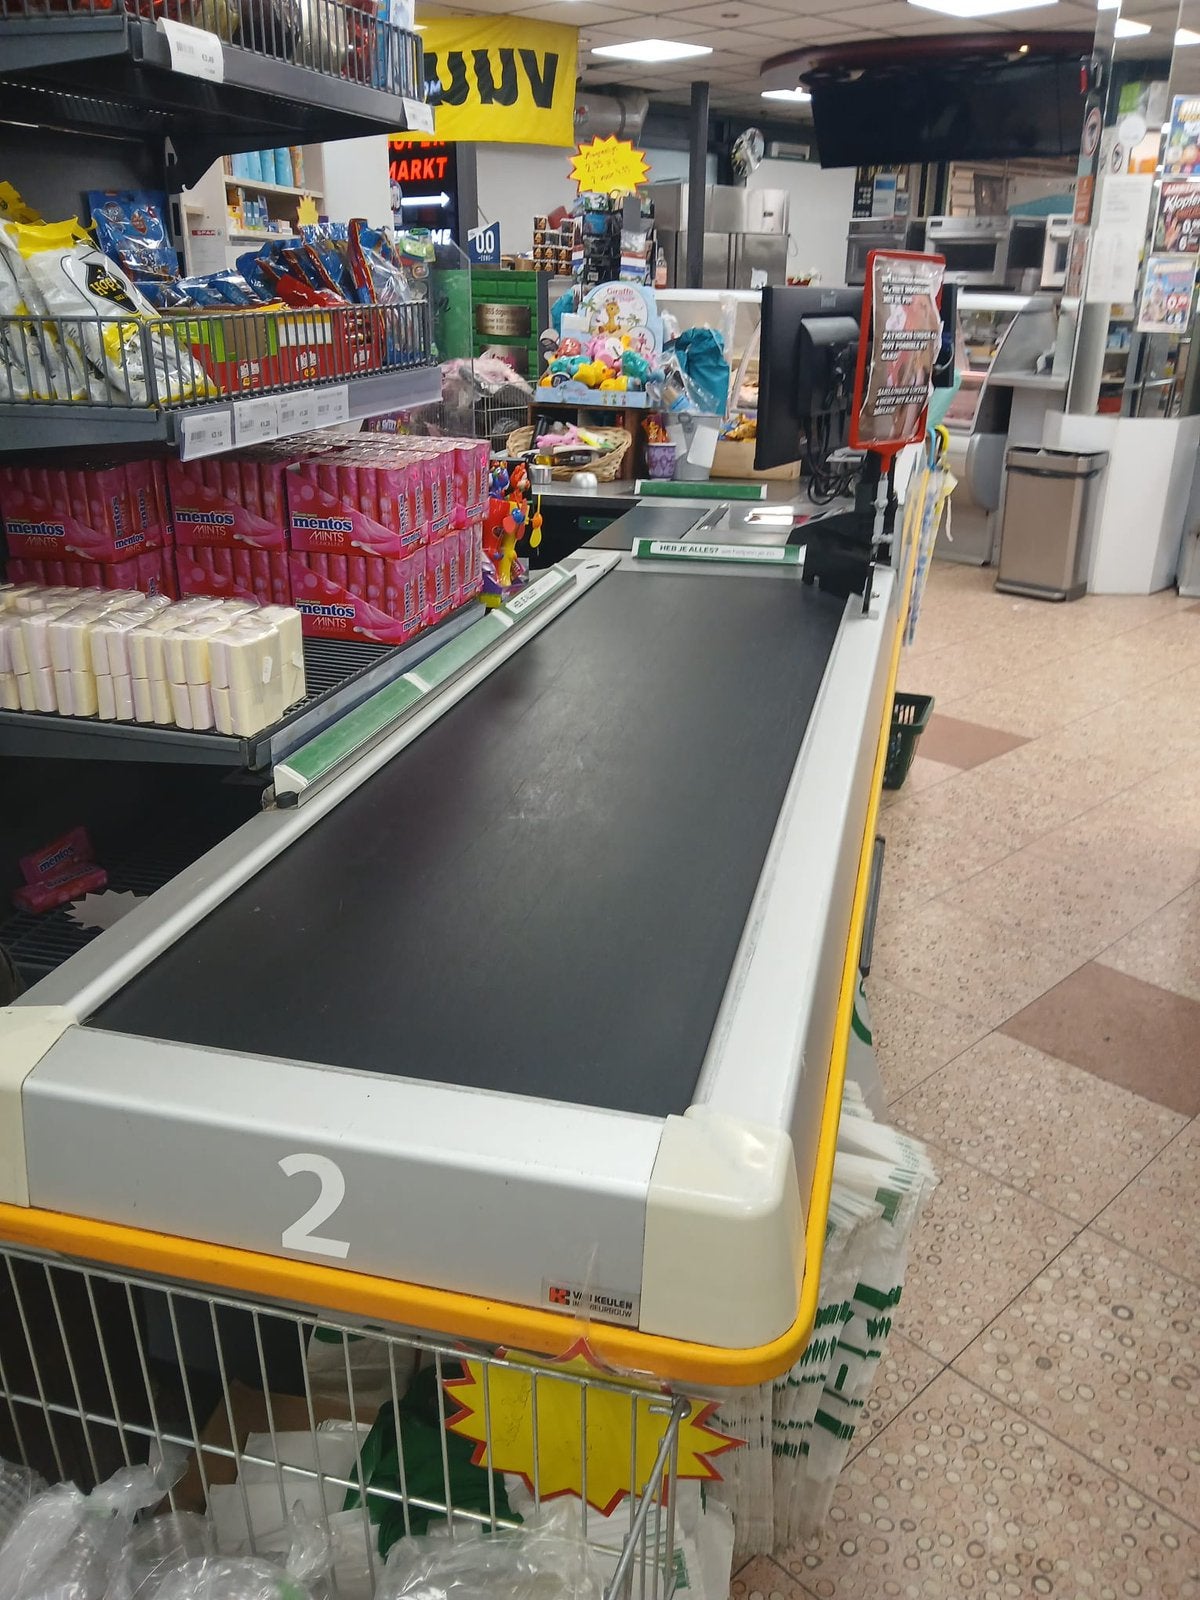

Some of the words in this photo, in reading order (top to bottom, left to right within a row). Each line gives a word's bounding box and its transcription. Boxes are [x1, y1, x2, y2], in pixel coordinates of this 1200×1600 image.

[176, 512, 234, 524] mentos
[293, 517, 352, 531] mentos
[8, 522, 64, 535] mentos
[192, 525, 226, 536] MINTS
[25, 536, 57, 547] MINTS
[115, 534, 144, 548] mentos
[309, 531, 344, 543] MINTS
[688, 546, 719, 554] ALLES?
[296, 604, 354, 617] mentos
[312, 617, 347, 628] MINTS
[40, 846, 74, 872] mentos
[277, 1152, 351, 1259] 2
[594, 1295, 632, 1310] KEULEN
